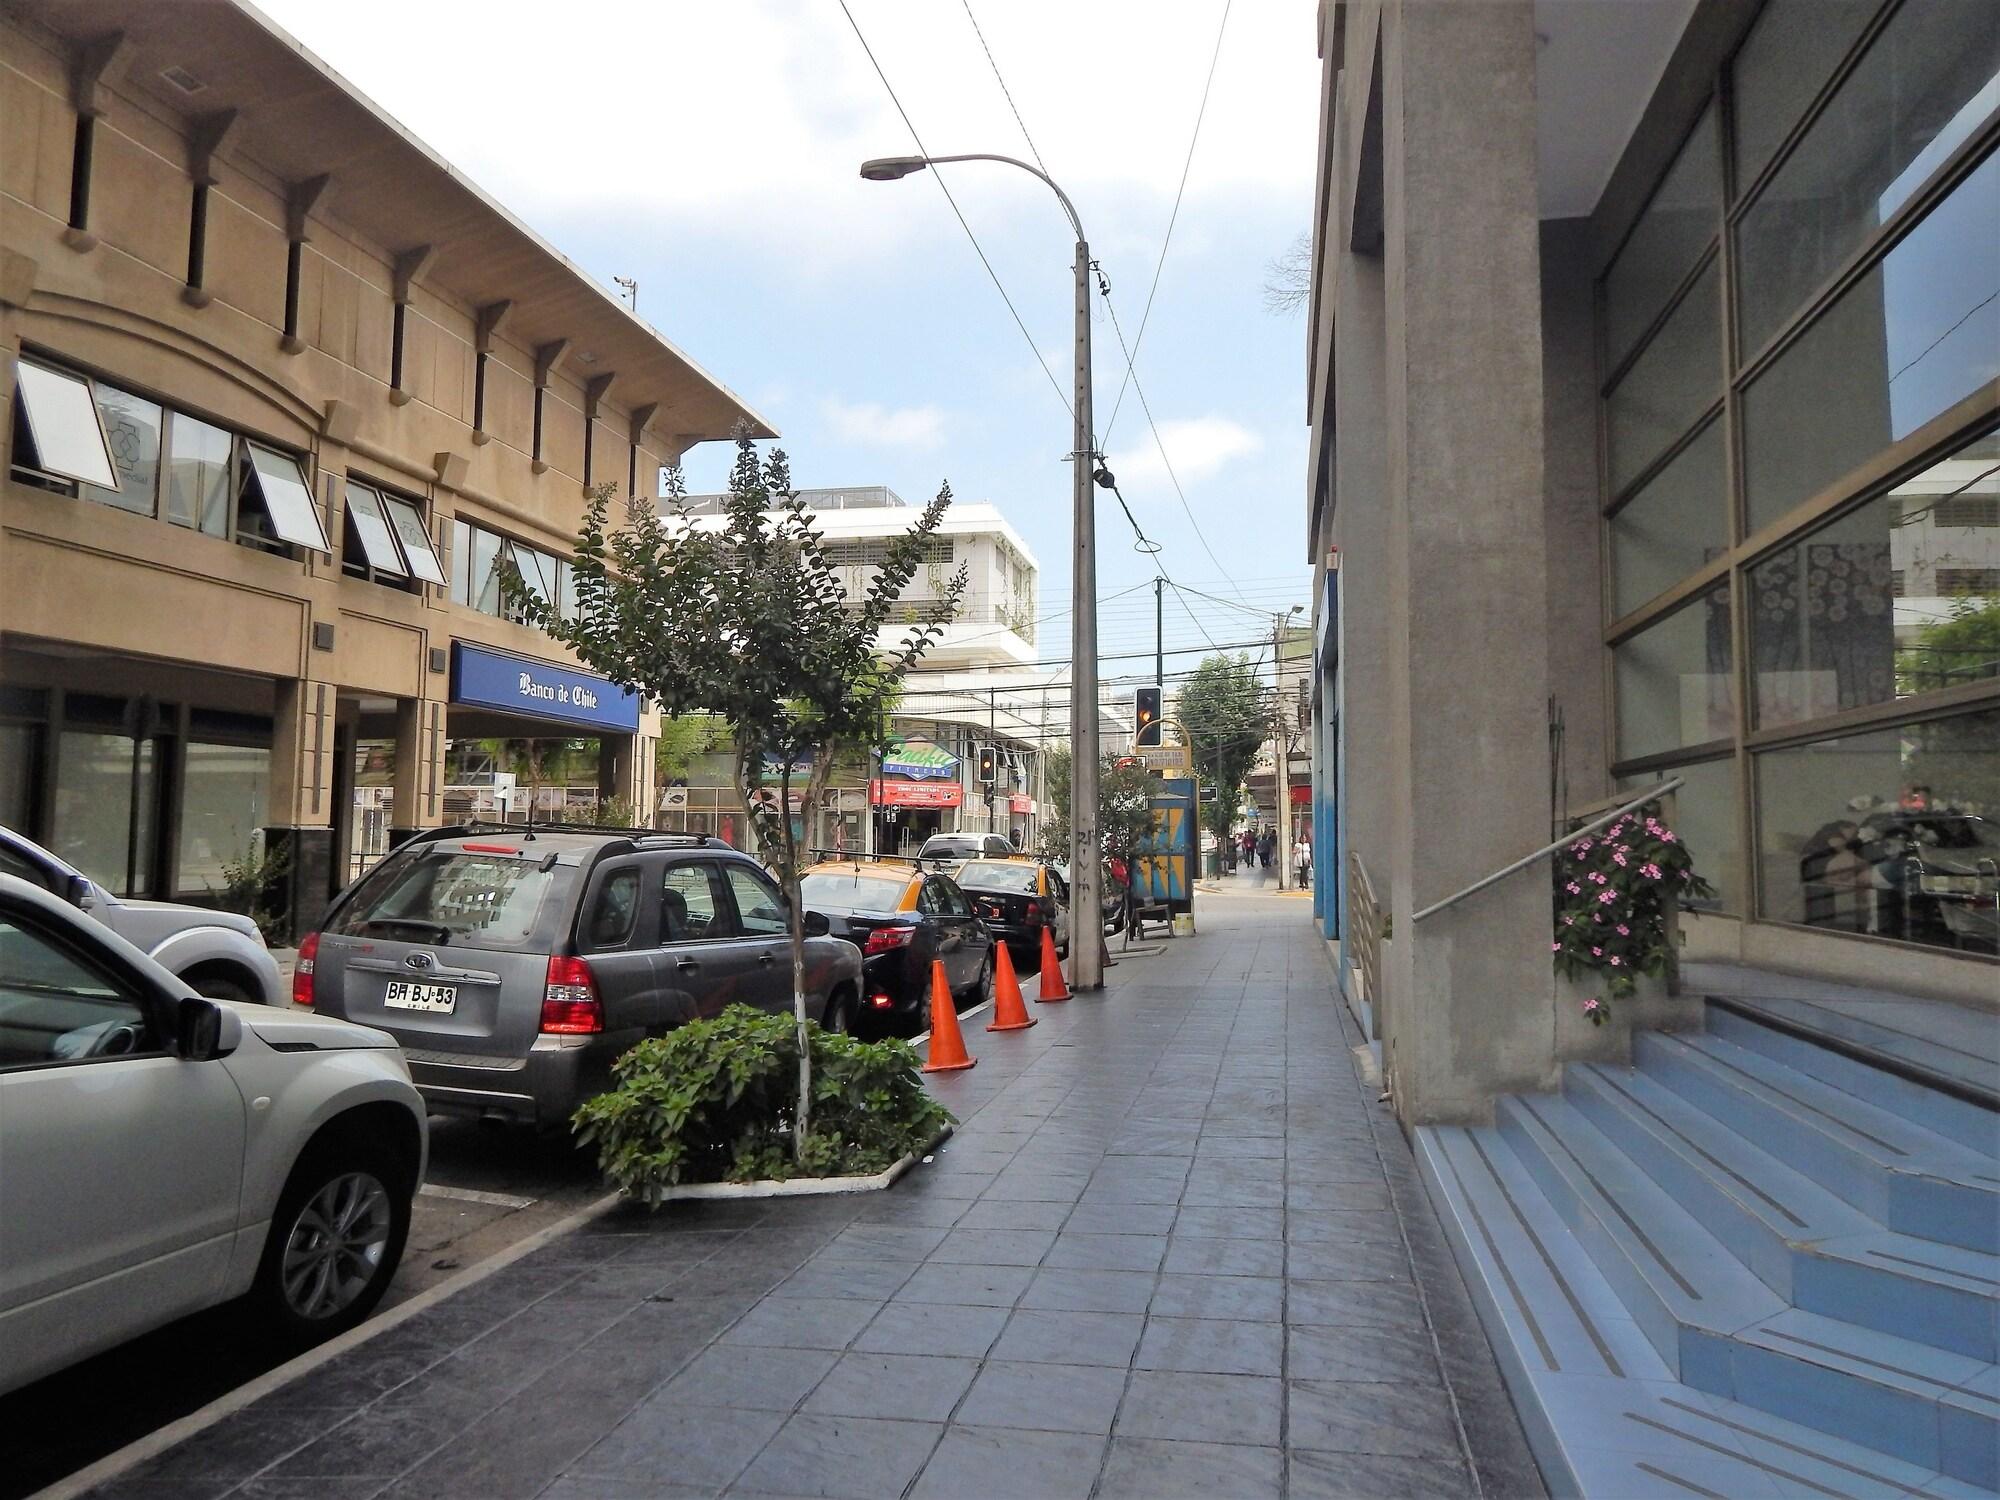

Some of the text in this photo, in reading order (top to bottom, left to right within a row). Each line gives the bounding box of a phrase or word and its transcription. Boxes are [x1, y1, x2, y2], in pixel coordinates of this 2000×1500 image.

[519, 672, 597, 709] Banco de Chile
[889, 765, 946, 776] FITNESS
